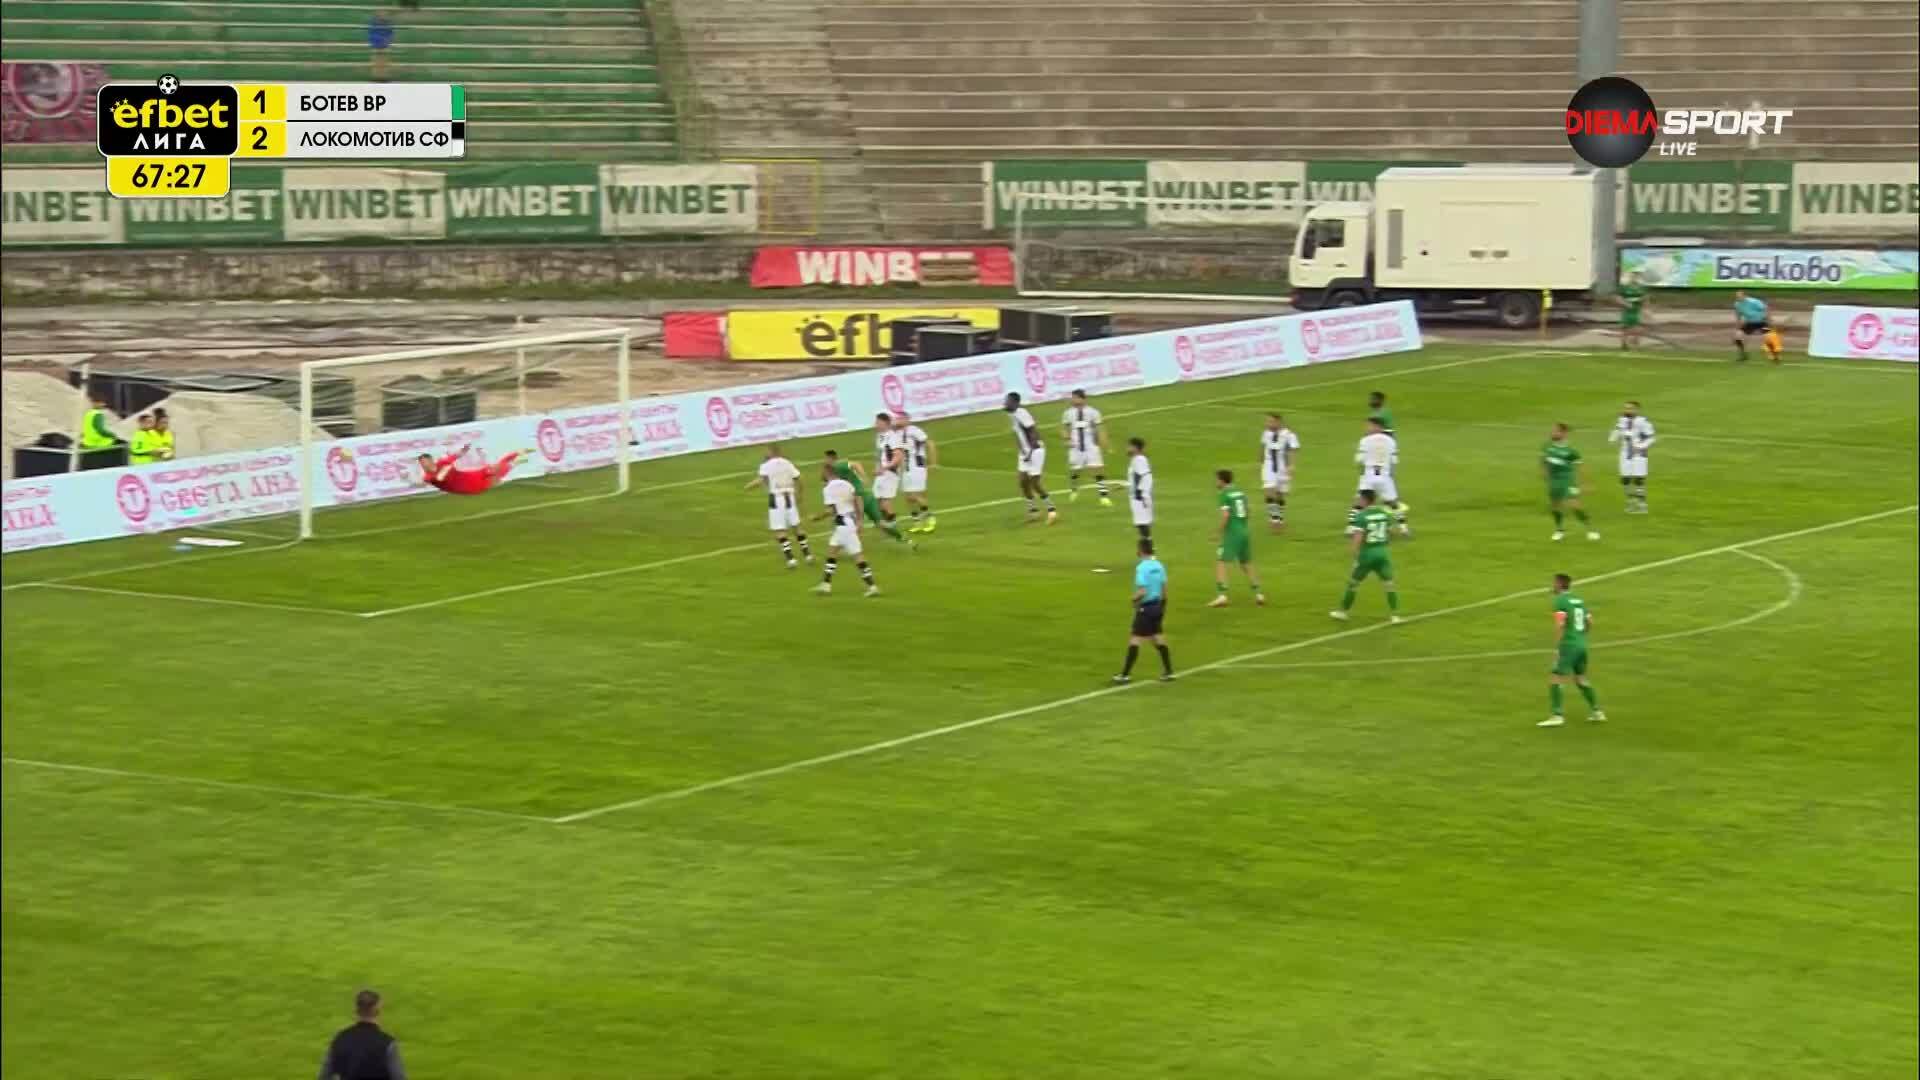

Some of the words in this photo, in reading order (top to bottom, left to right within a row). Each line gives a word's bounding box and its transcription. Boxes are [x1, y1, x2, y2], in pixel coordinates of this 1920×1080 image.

[2, 191, 111, 222] INBET
[127, 188, 279, 222] WINBET
[288, 188, 438, 220] WINBET
[450, 185, 597, 218] WINBET
[606, 184, 752, 214] WINBET
[999, 180, 1144, 210] WINBET
[1152, 181, 1297, 210] WINBET
[1309, 181, 1377, 202] WIN
[1632, 183, 1789, 214] WINBET
[1800, 183, 1919, 214] WINBE
[796, 251, 974, 285] WINB
[1715, 256, 1841, 281] Бачково
[800, 312, 892, 357] efb
